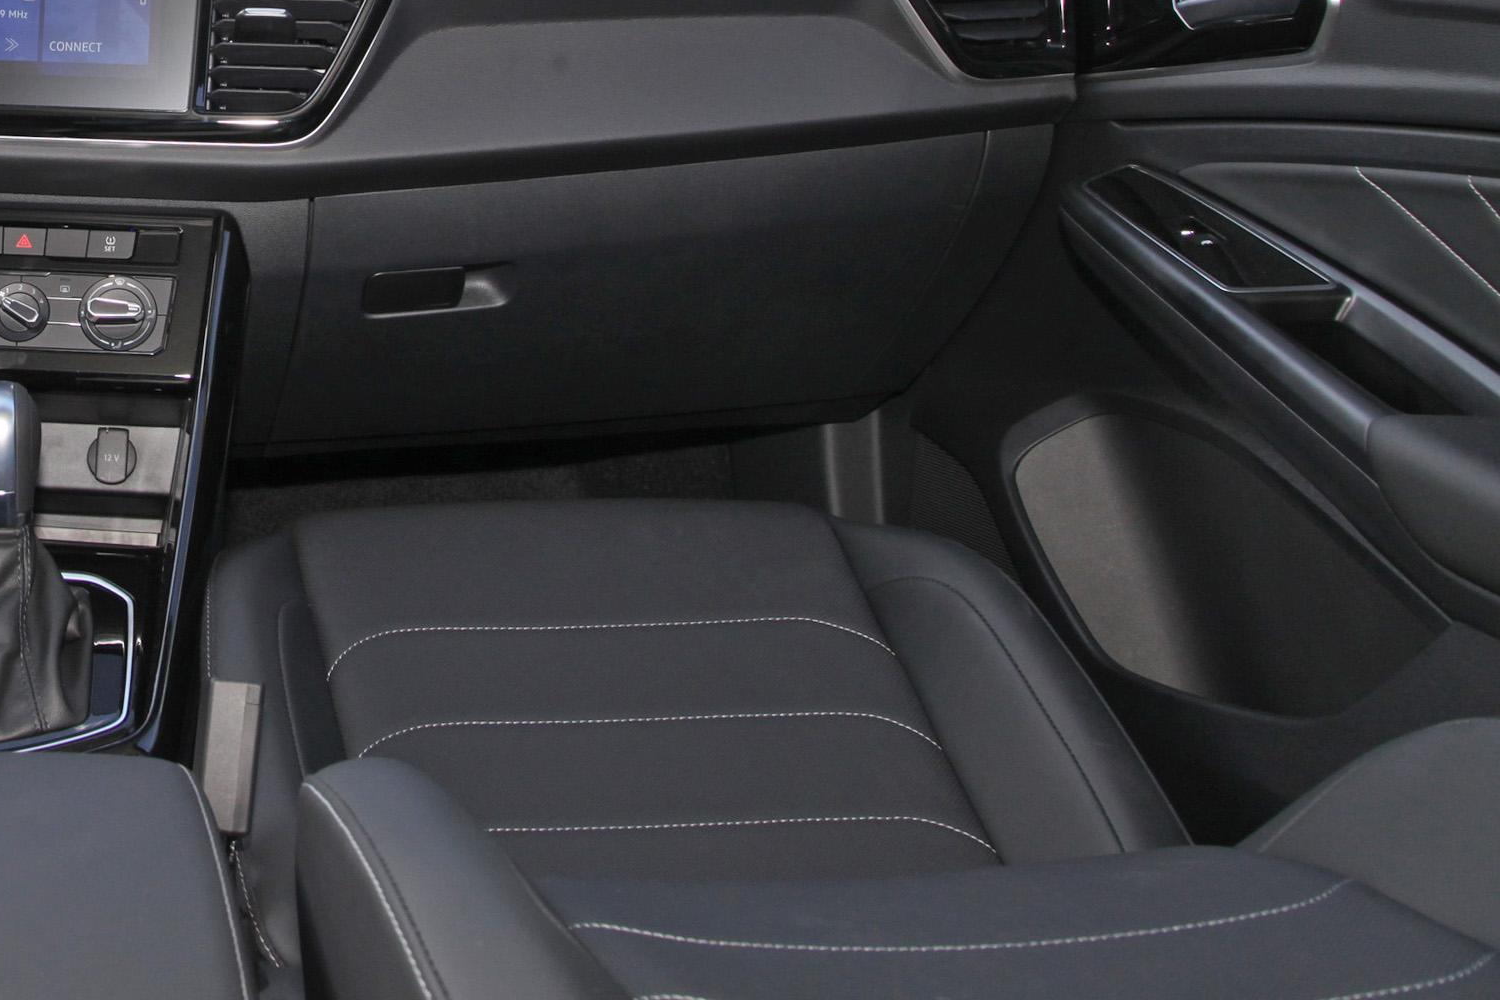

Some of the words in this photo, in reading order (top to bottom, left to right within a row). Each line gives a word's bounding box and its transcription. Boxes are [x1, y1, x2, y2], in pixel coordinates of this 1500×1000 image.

[8, 9, 29, 20] MHz
[49, 41, 103, 53] CONNECT
[103, 453, 111, 462] 12
[113, 454, 120, 462] V
